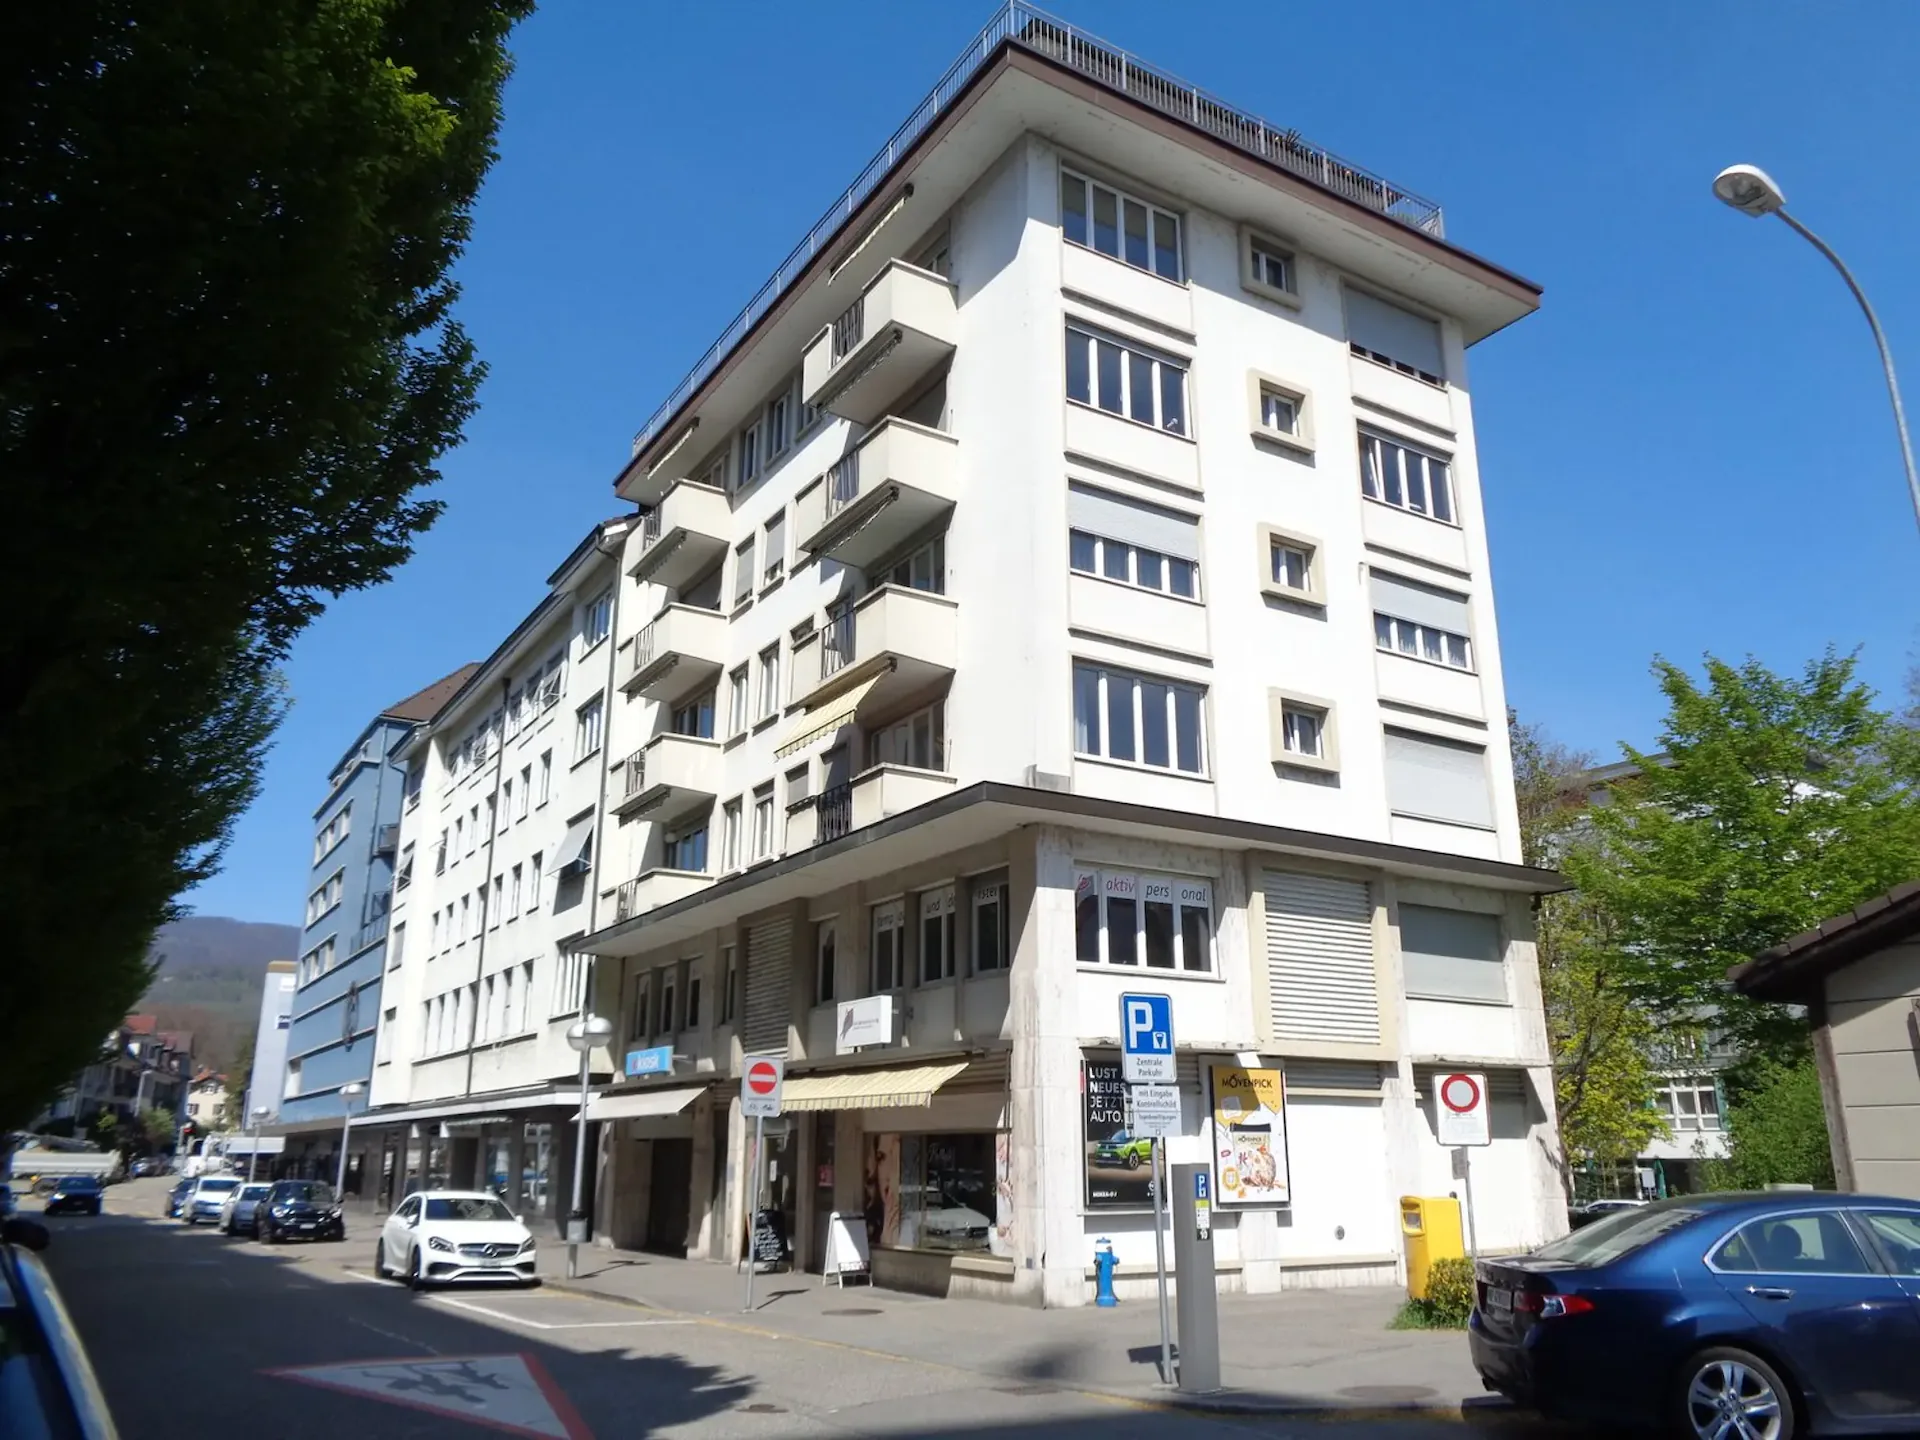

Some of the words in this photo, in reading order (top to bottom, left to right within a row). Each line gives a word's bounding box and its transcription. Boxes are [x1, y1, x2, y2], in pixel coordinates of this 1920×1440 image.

[1106, 878, 1135, 892] aktiv
[1146, 884, 1170, 898] pers
[1181, 888, 1207, 901] onal
[1128, 1001, 1154, 1049] P
[1136, 1056, 1163, 1067] Zentrale
[1089, 1067, 1118, 1079] LUST
[1138, 1068, 1163, 1077] Parkuhr
[1089, 1081, 1126, 1094] NEUES
